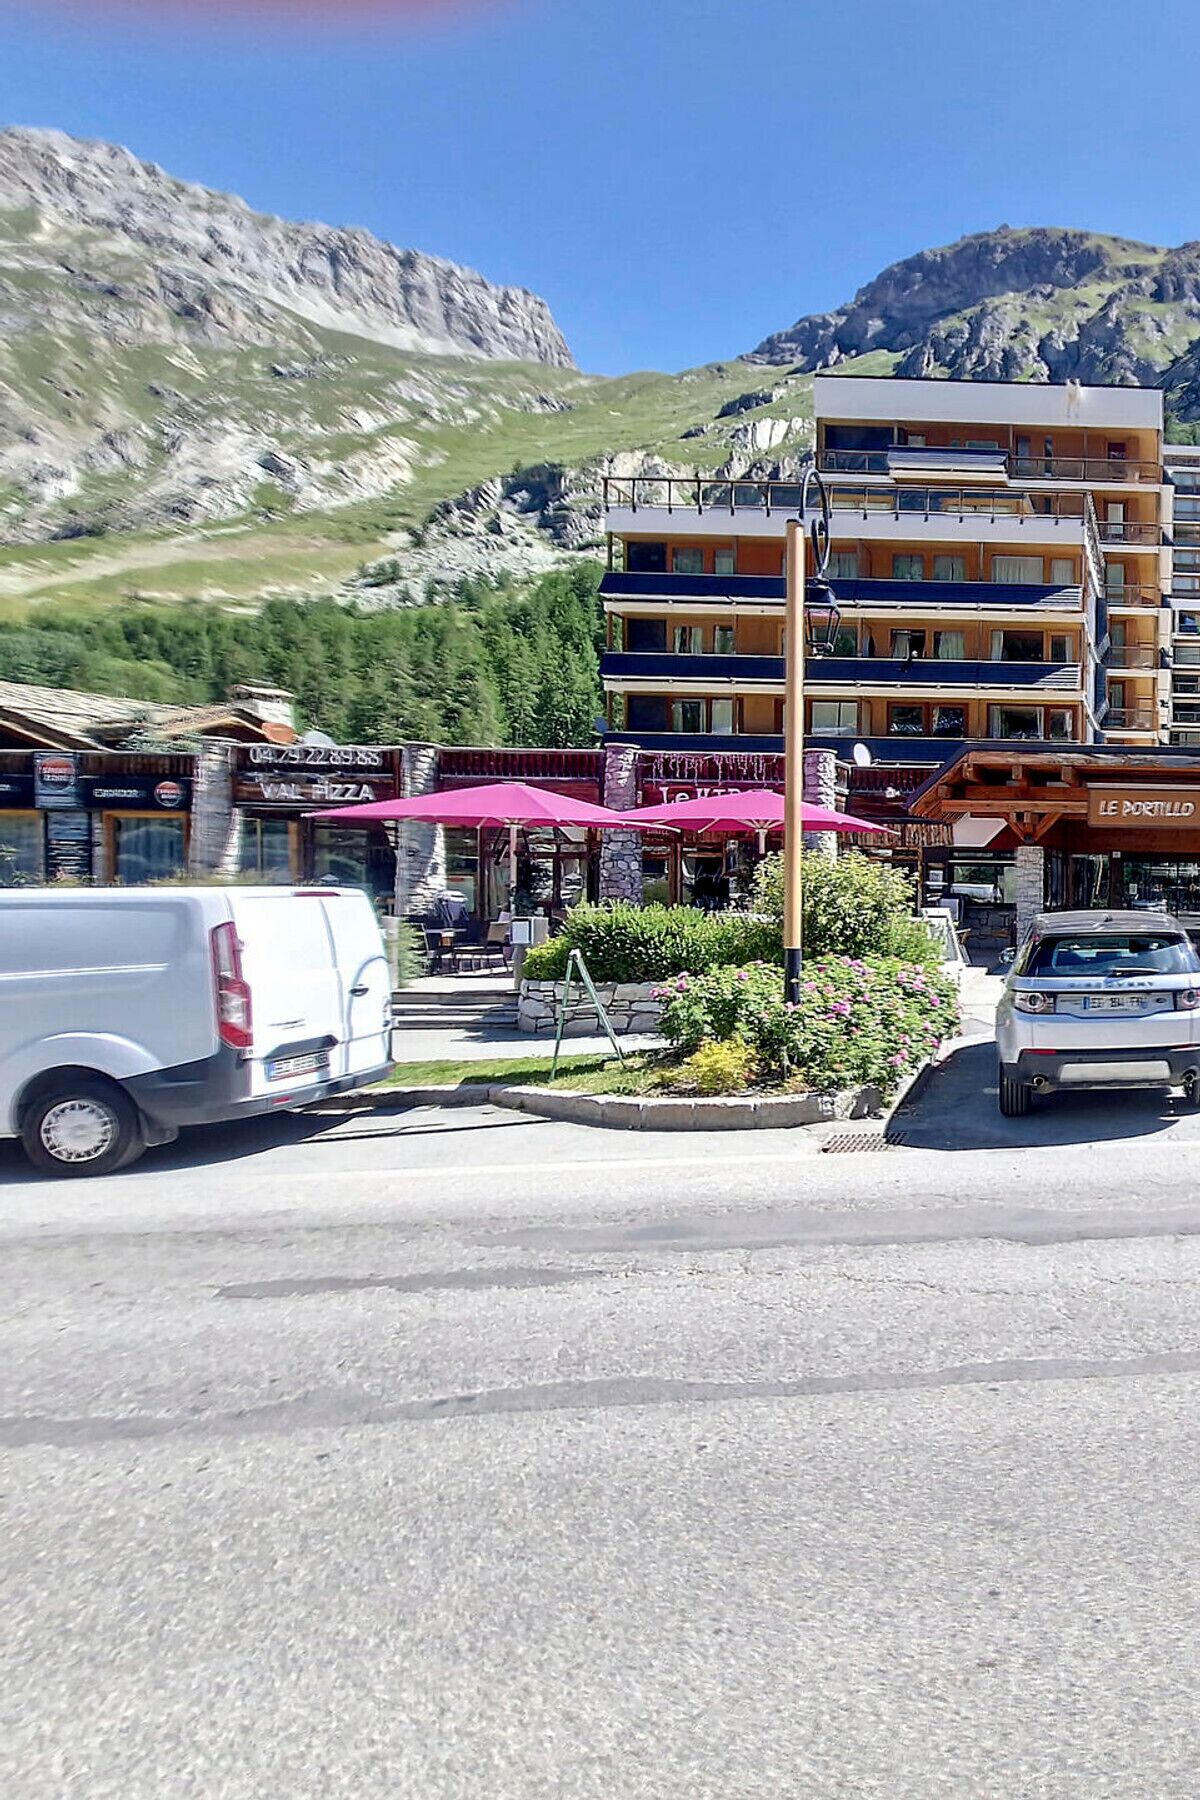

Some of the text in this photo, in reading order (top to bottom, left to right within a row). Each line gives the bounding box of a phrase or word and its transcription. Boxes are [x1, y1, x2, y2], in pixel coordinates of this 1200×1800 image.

[260, 781, 376, 801] VAL PIZZA
[1099, 799, 1195, 817] LE PORTILLO
